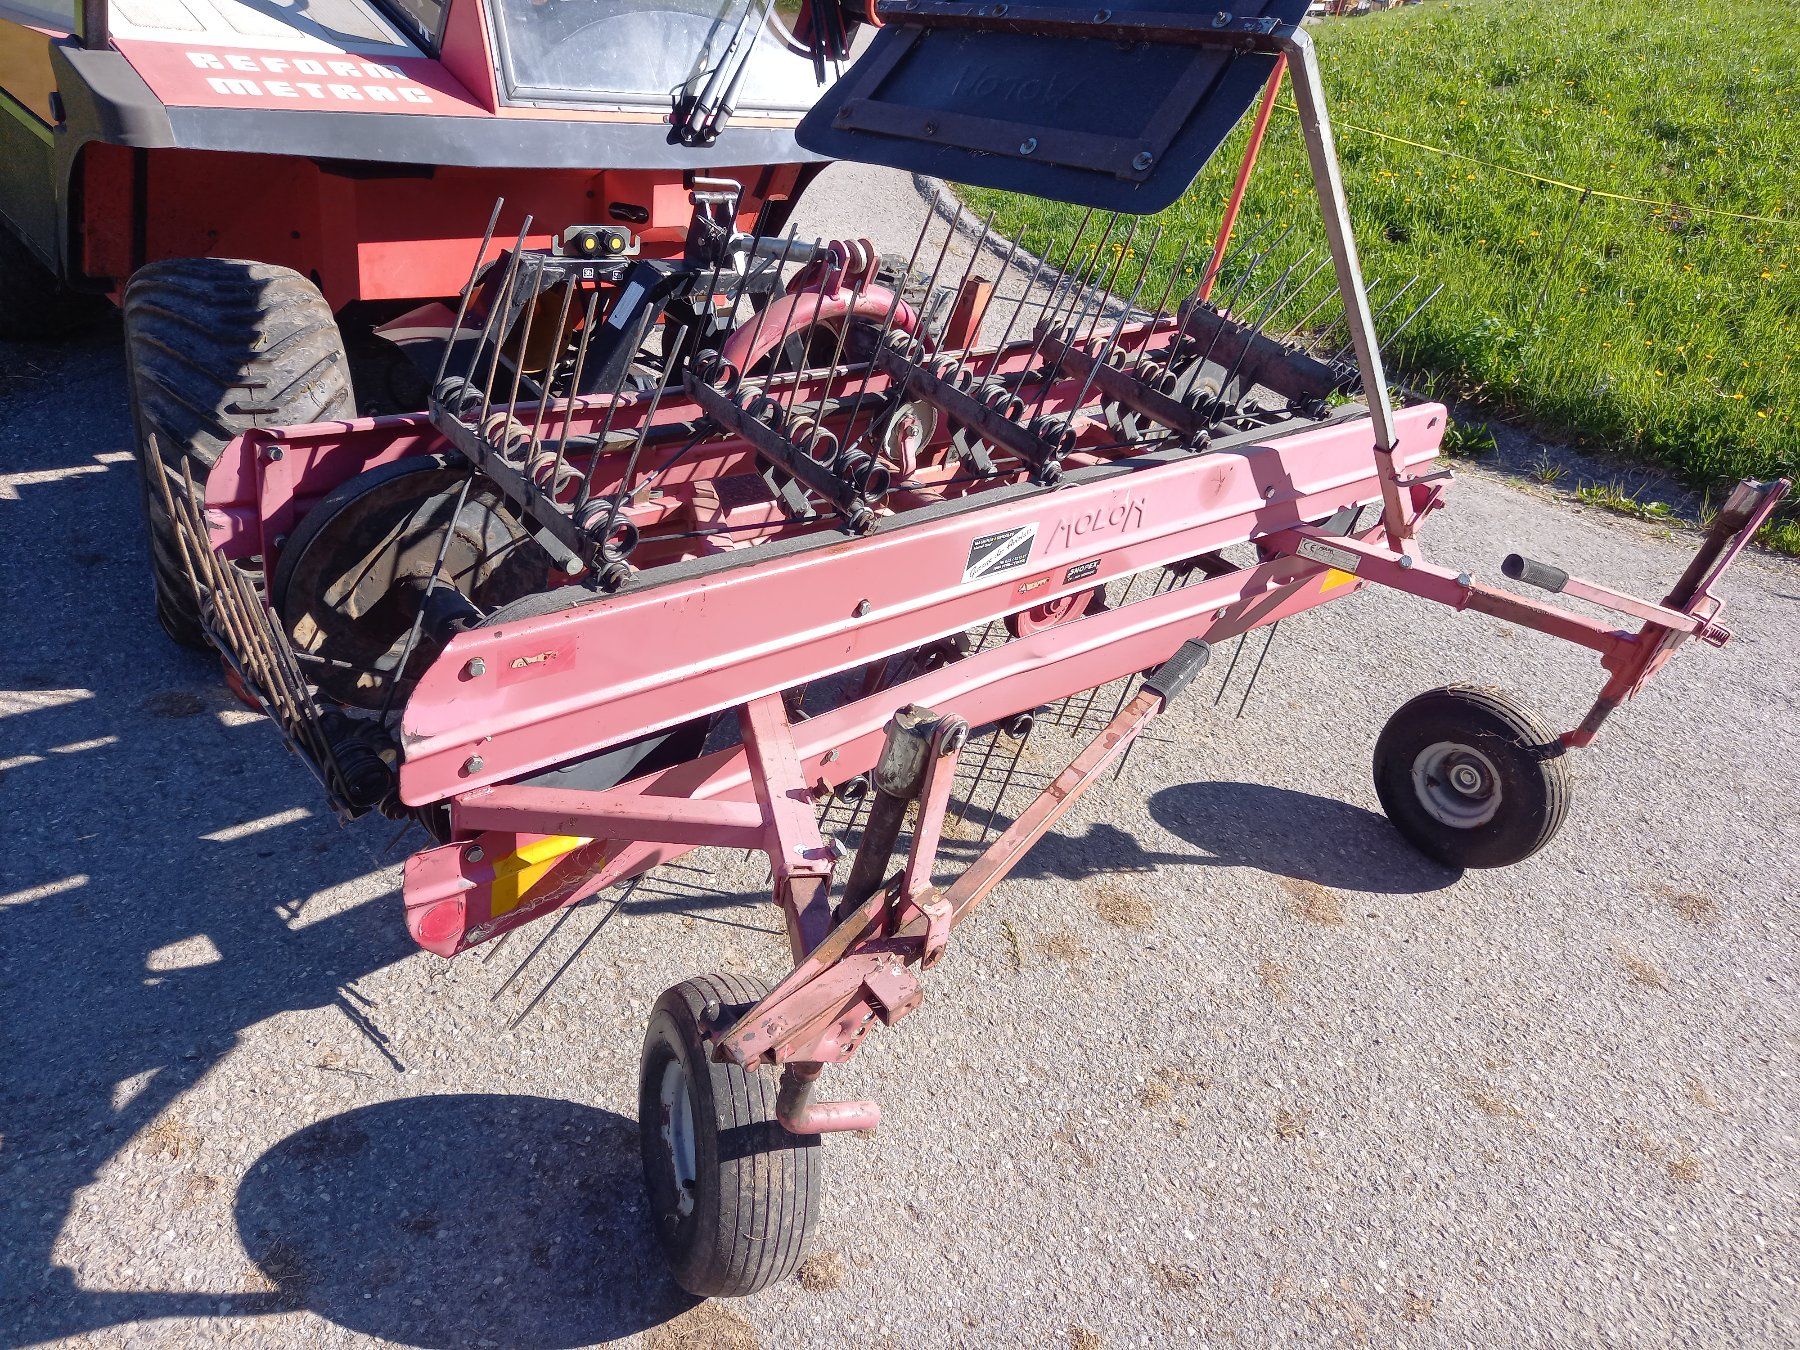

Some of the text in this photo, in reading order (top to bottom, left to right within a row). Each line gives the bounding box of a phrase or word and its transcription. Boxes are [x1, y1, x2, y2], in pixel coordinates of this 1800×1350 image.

[185, 51, 410, 80] REFORM
[206, 76, 434, 104] METRAC
[1043, 497, 1145, 555] MOLON
